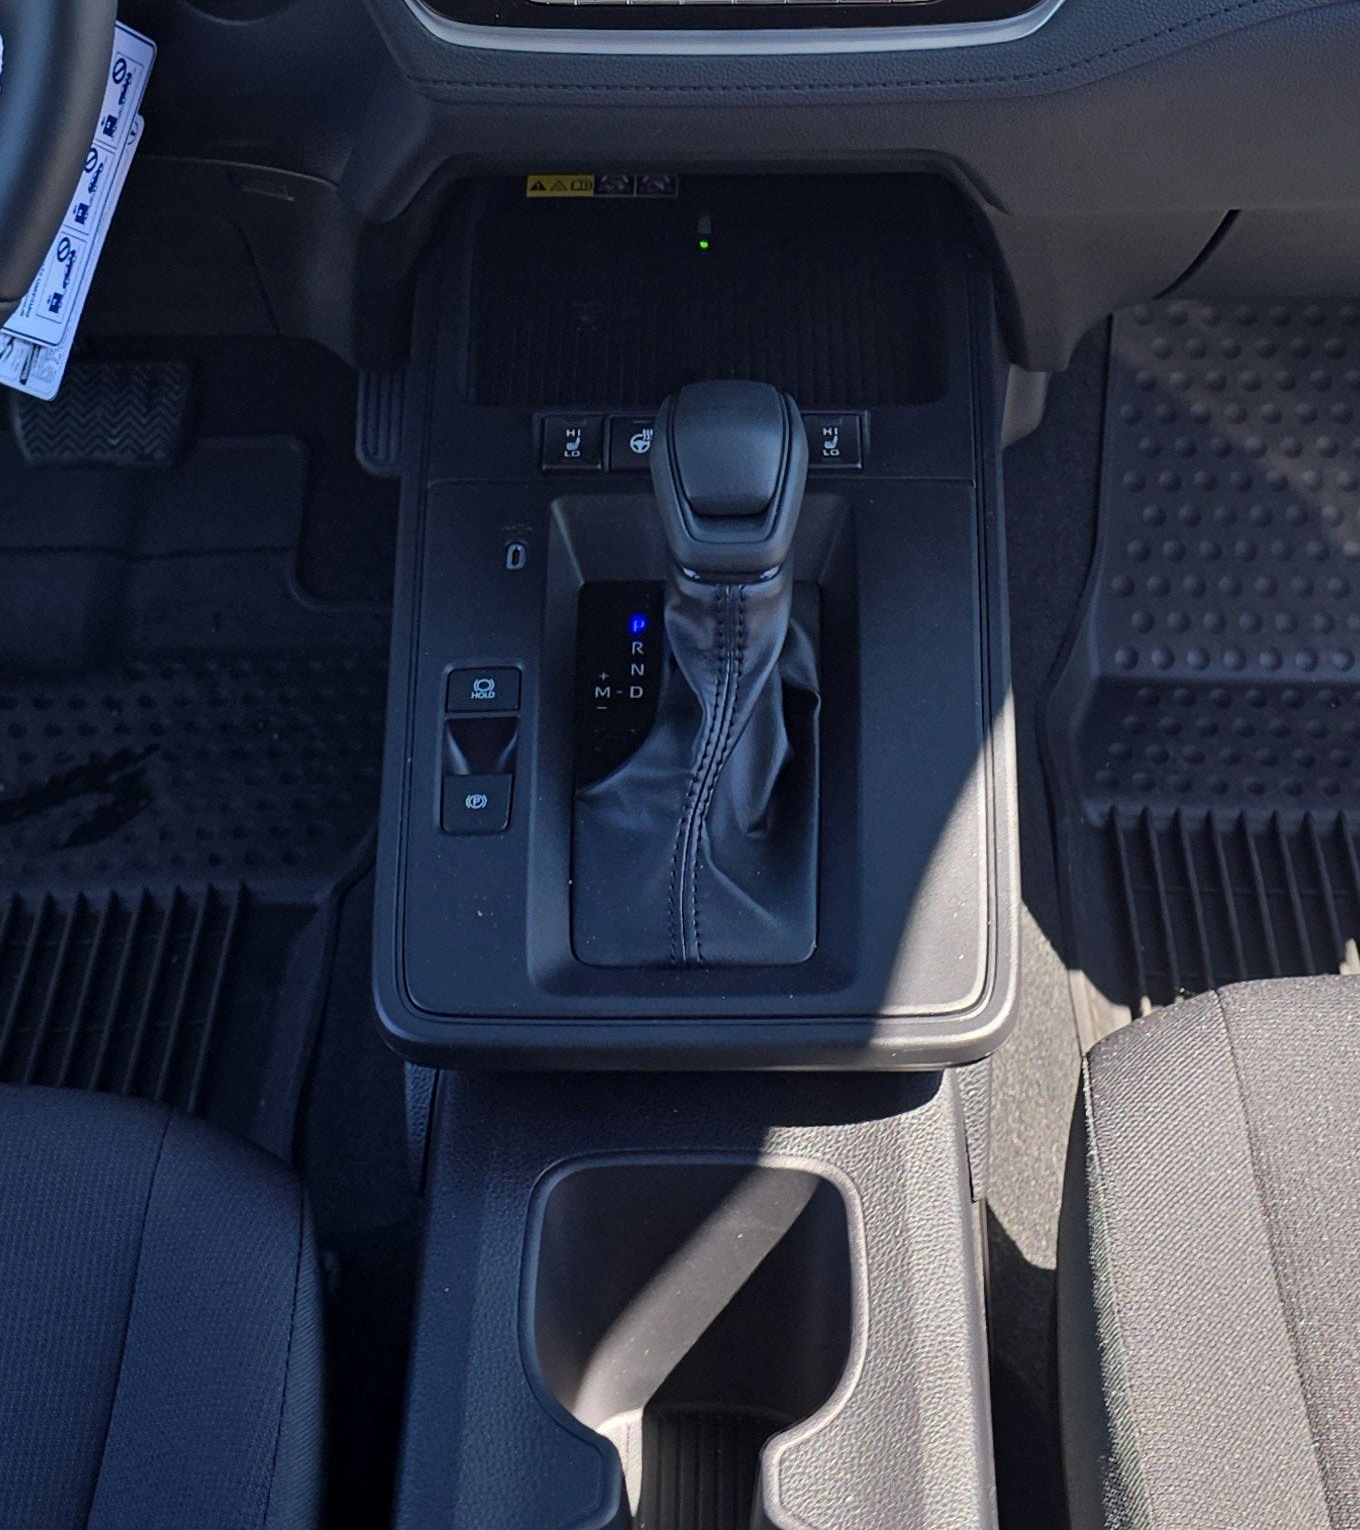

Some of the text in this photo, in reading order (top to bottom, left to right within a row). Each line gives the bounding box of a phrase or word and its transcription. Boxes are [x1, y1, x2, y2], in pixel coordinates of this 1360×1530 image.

[566, 429, 581, 438] HI
[823, 427, 839, 436] HI
[564, 450, 581, 458] LO
[822, 449, 840, 457] LO
[633, 620, 645, 632] P
[631, 641, 644, 656] R
[631, 663, 645, 677] N
[471, 690, 496, 700] HOLD
[594, 686, 644, 699] M D
